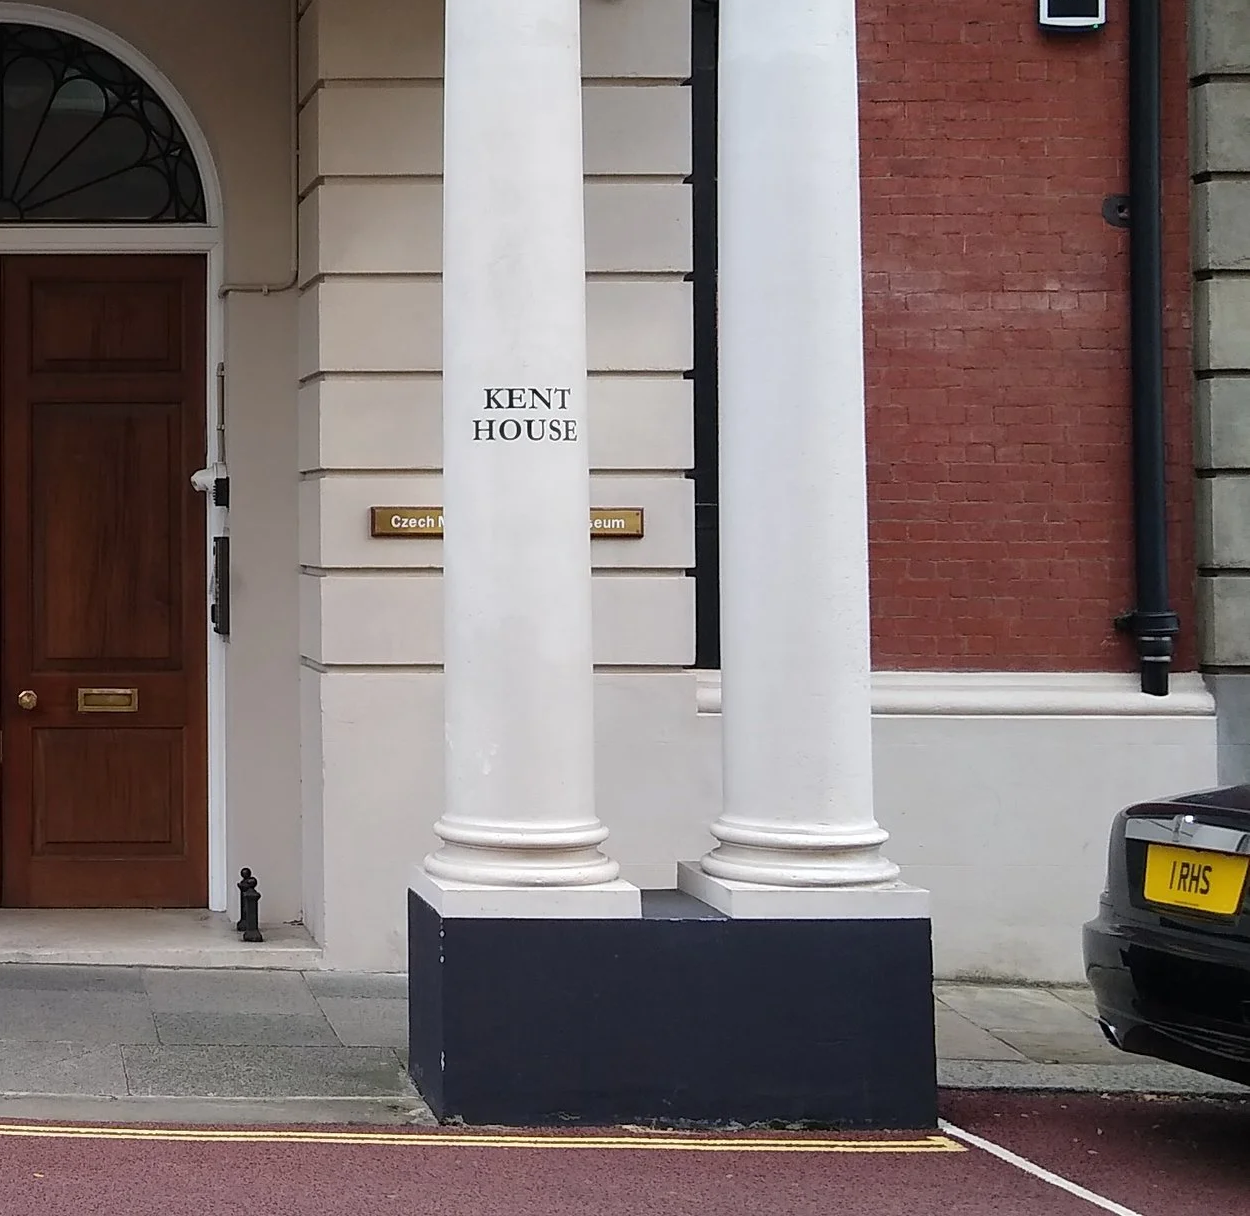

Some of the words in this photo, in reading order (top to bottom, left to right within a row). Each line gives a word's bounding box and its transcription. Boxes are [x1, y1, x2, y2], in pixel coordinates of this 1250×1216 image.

[483, 388, 571, 410] KENT
[472, 418, 578, 441] HOUSE
[391, 515, 435, 528] Czech
